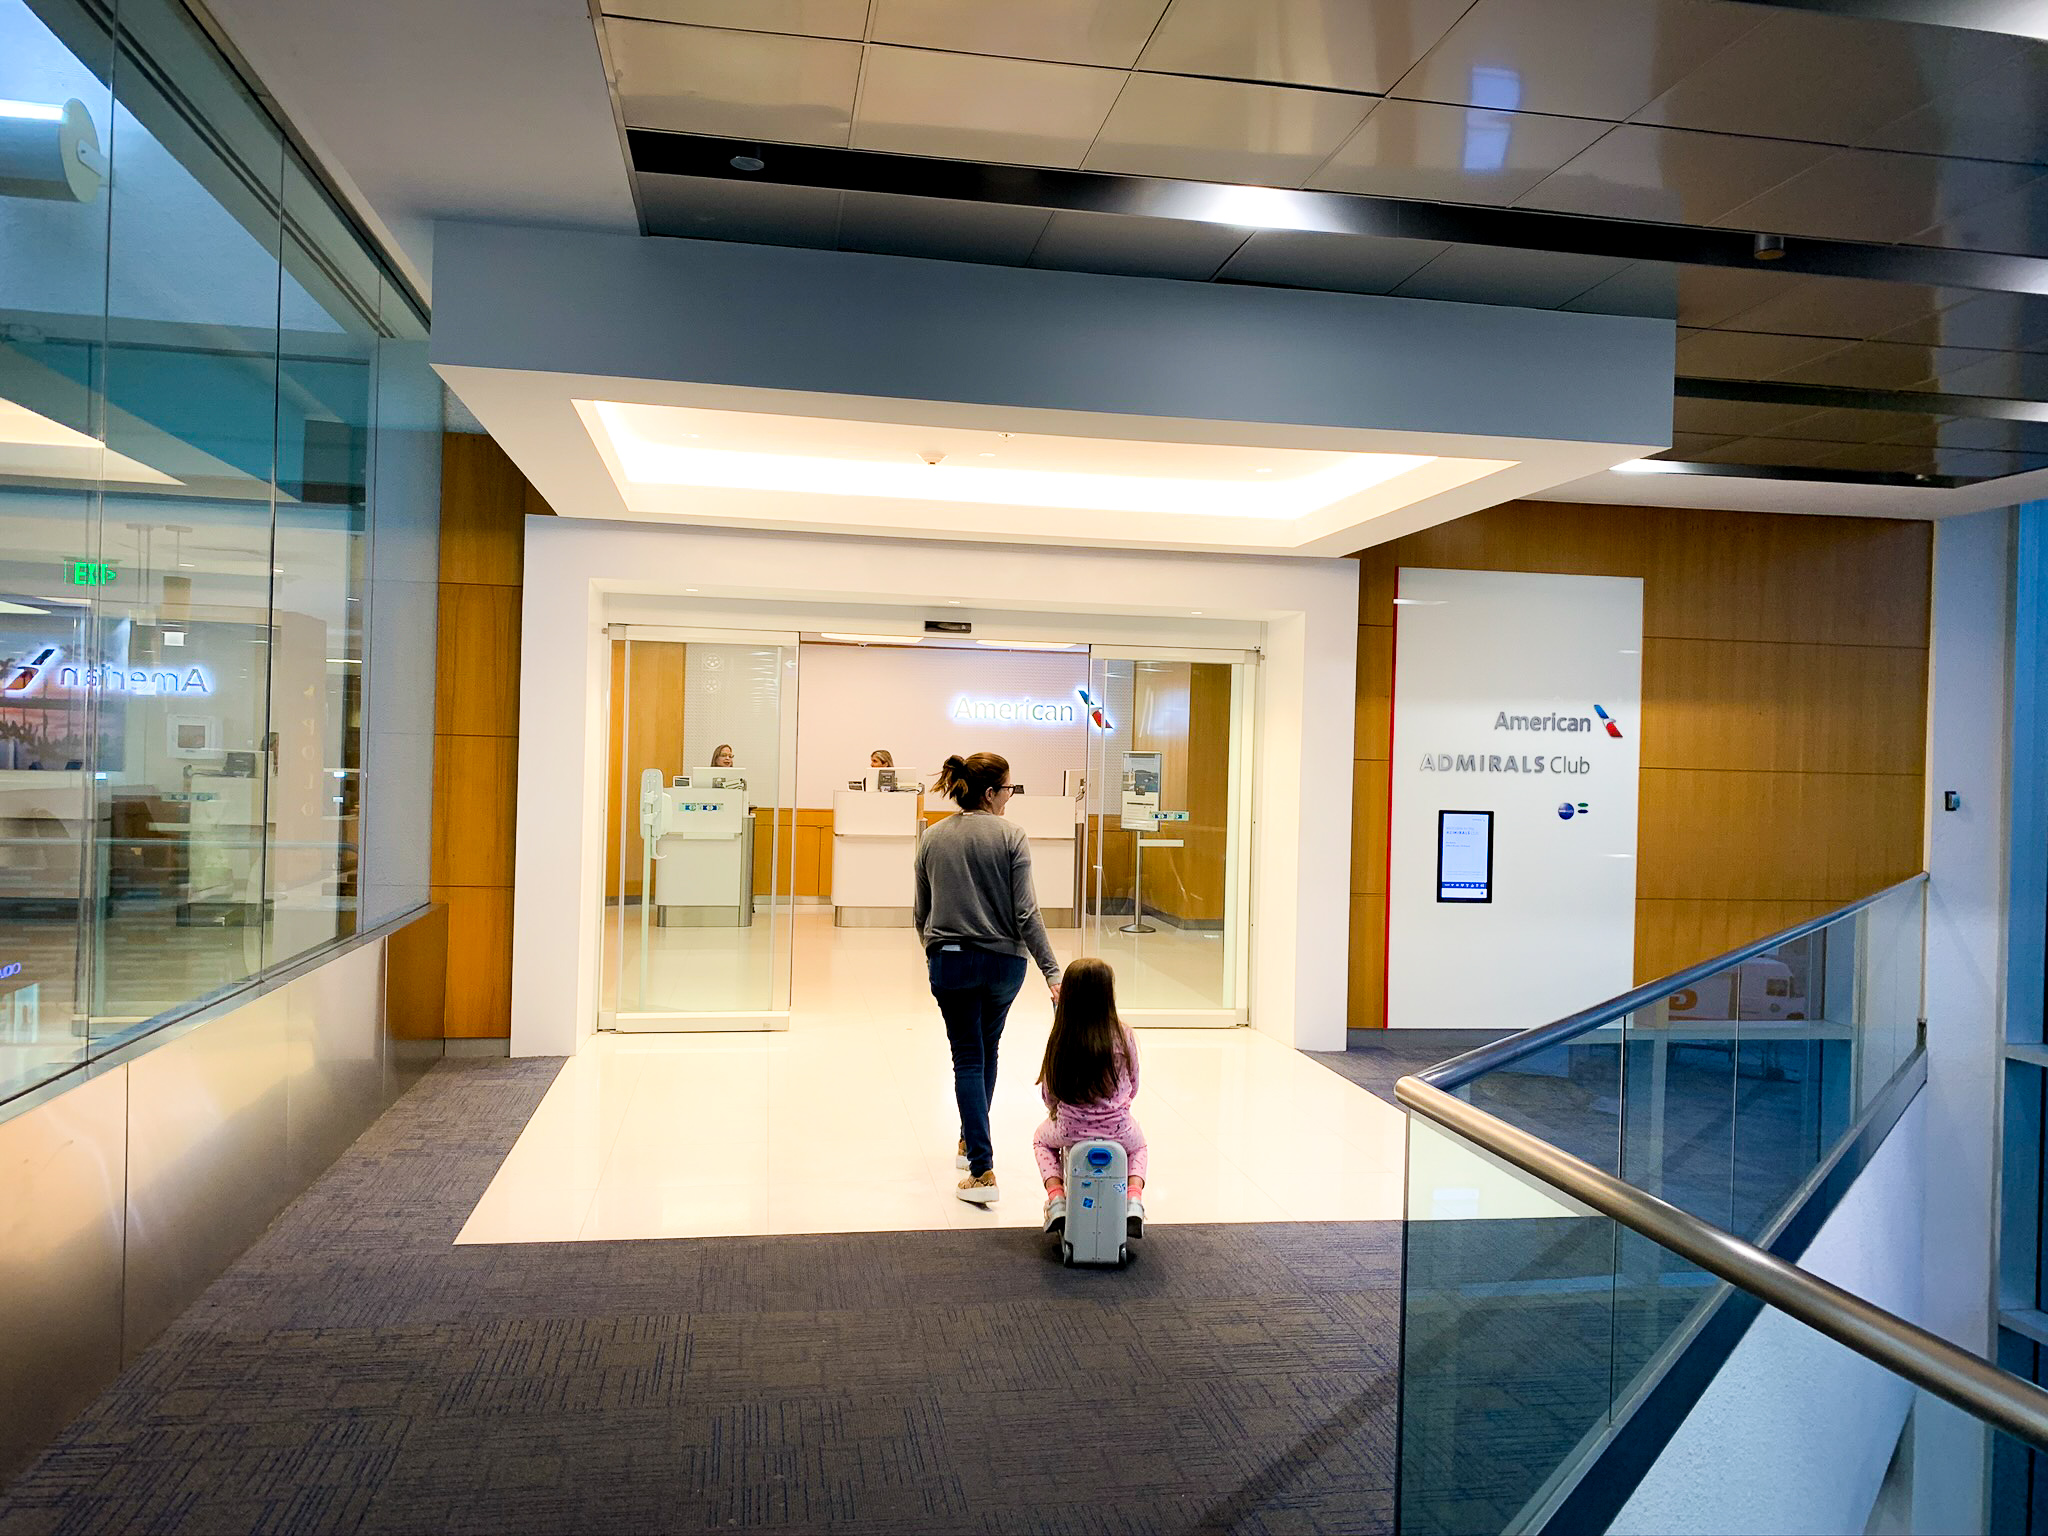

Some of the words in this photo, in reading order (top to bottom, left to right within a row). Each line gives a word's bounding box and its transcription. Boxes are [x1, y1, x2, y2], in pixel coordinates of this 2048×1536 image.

[74, 562, 109, 585] EXT
[955, 697, 1073, 721] American
[1494, 711, 1592, 732] American
[1420, 753, 1545, 773] ADMIRALS
[1550, 756, 1591, 774] Club
